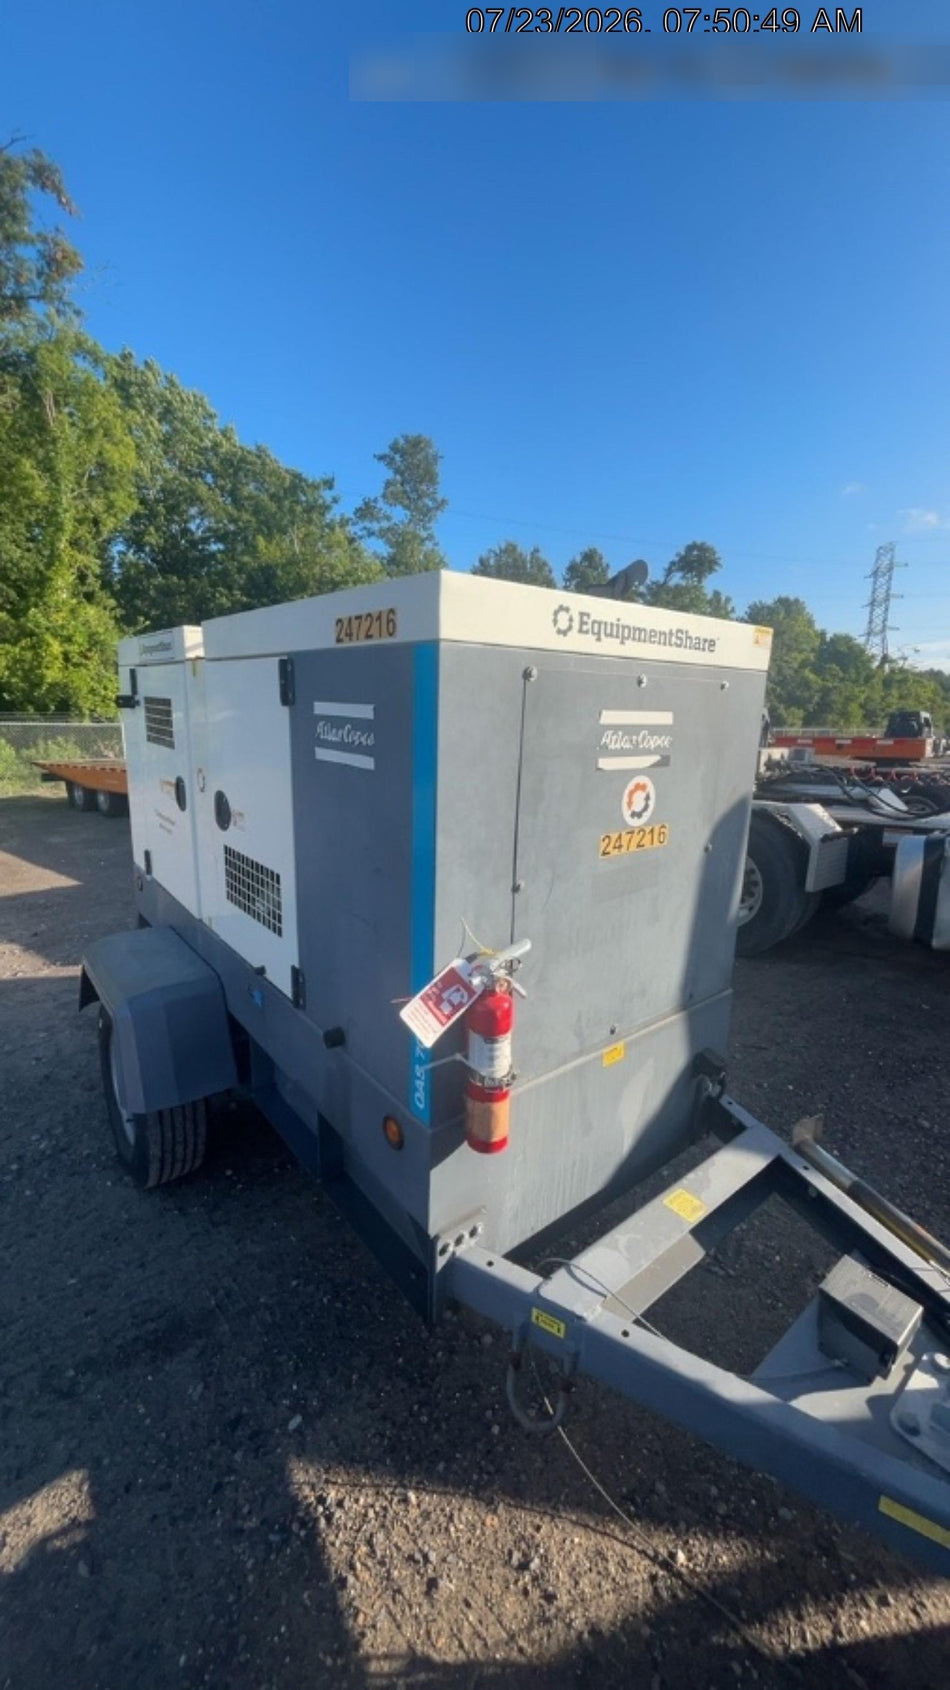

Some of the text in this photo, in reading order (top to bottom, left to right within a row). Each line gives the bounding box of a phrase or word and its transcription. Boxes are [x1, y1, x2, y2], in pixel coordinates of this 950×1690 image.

[335, 608, 397, 643] 247216
[578, 611, 717, 653] EquipmentShare
[601, 825, 668, 856] 247216
